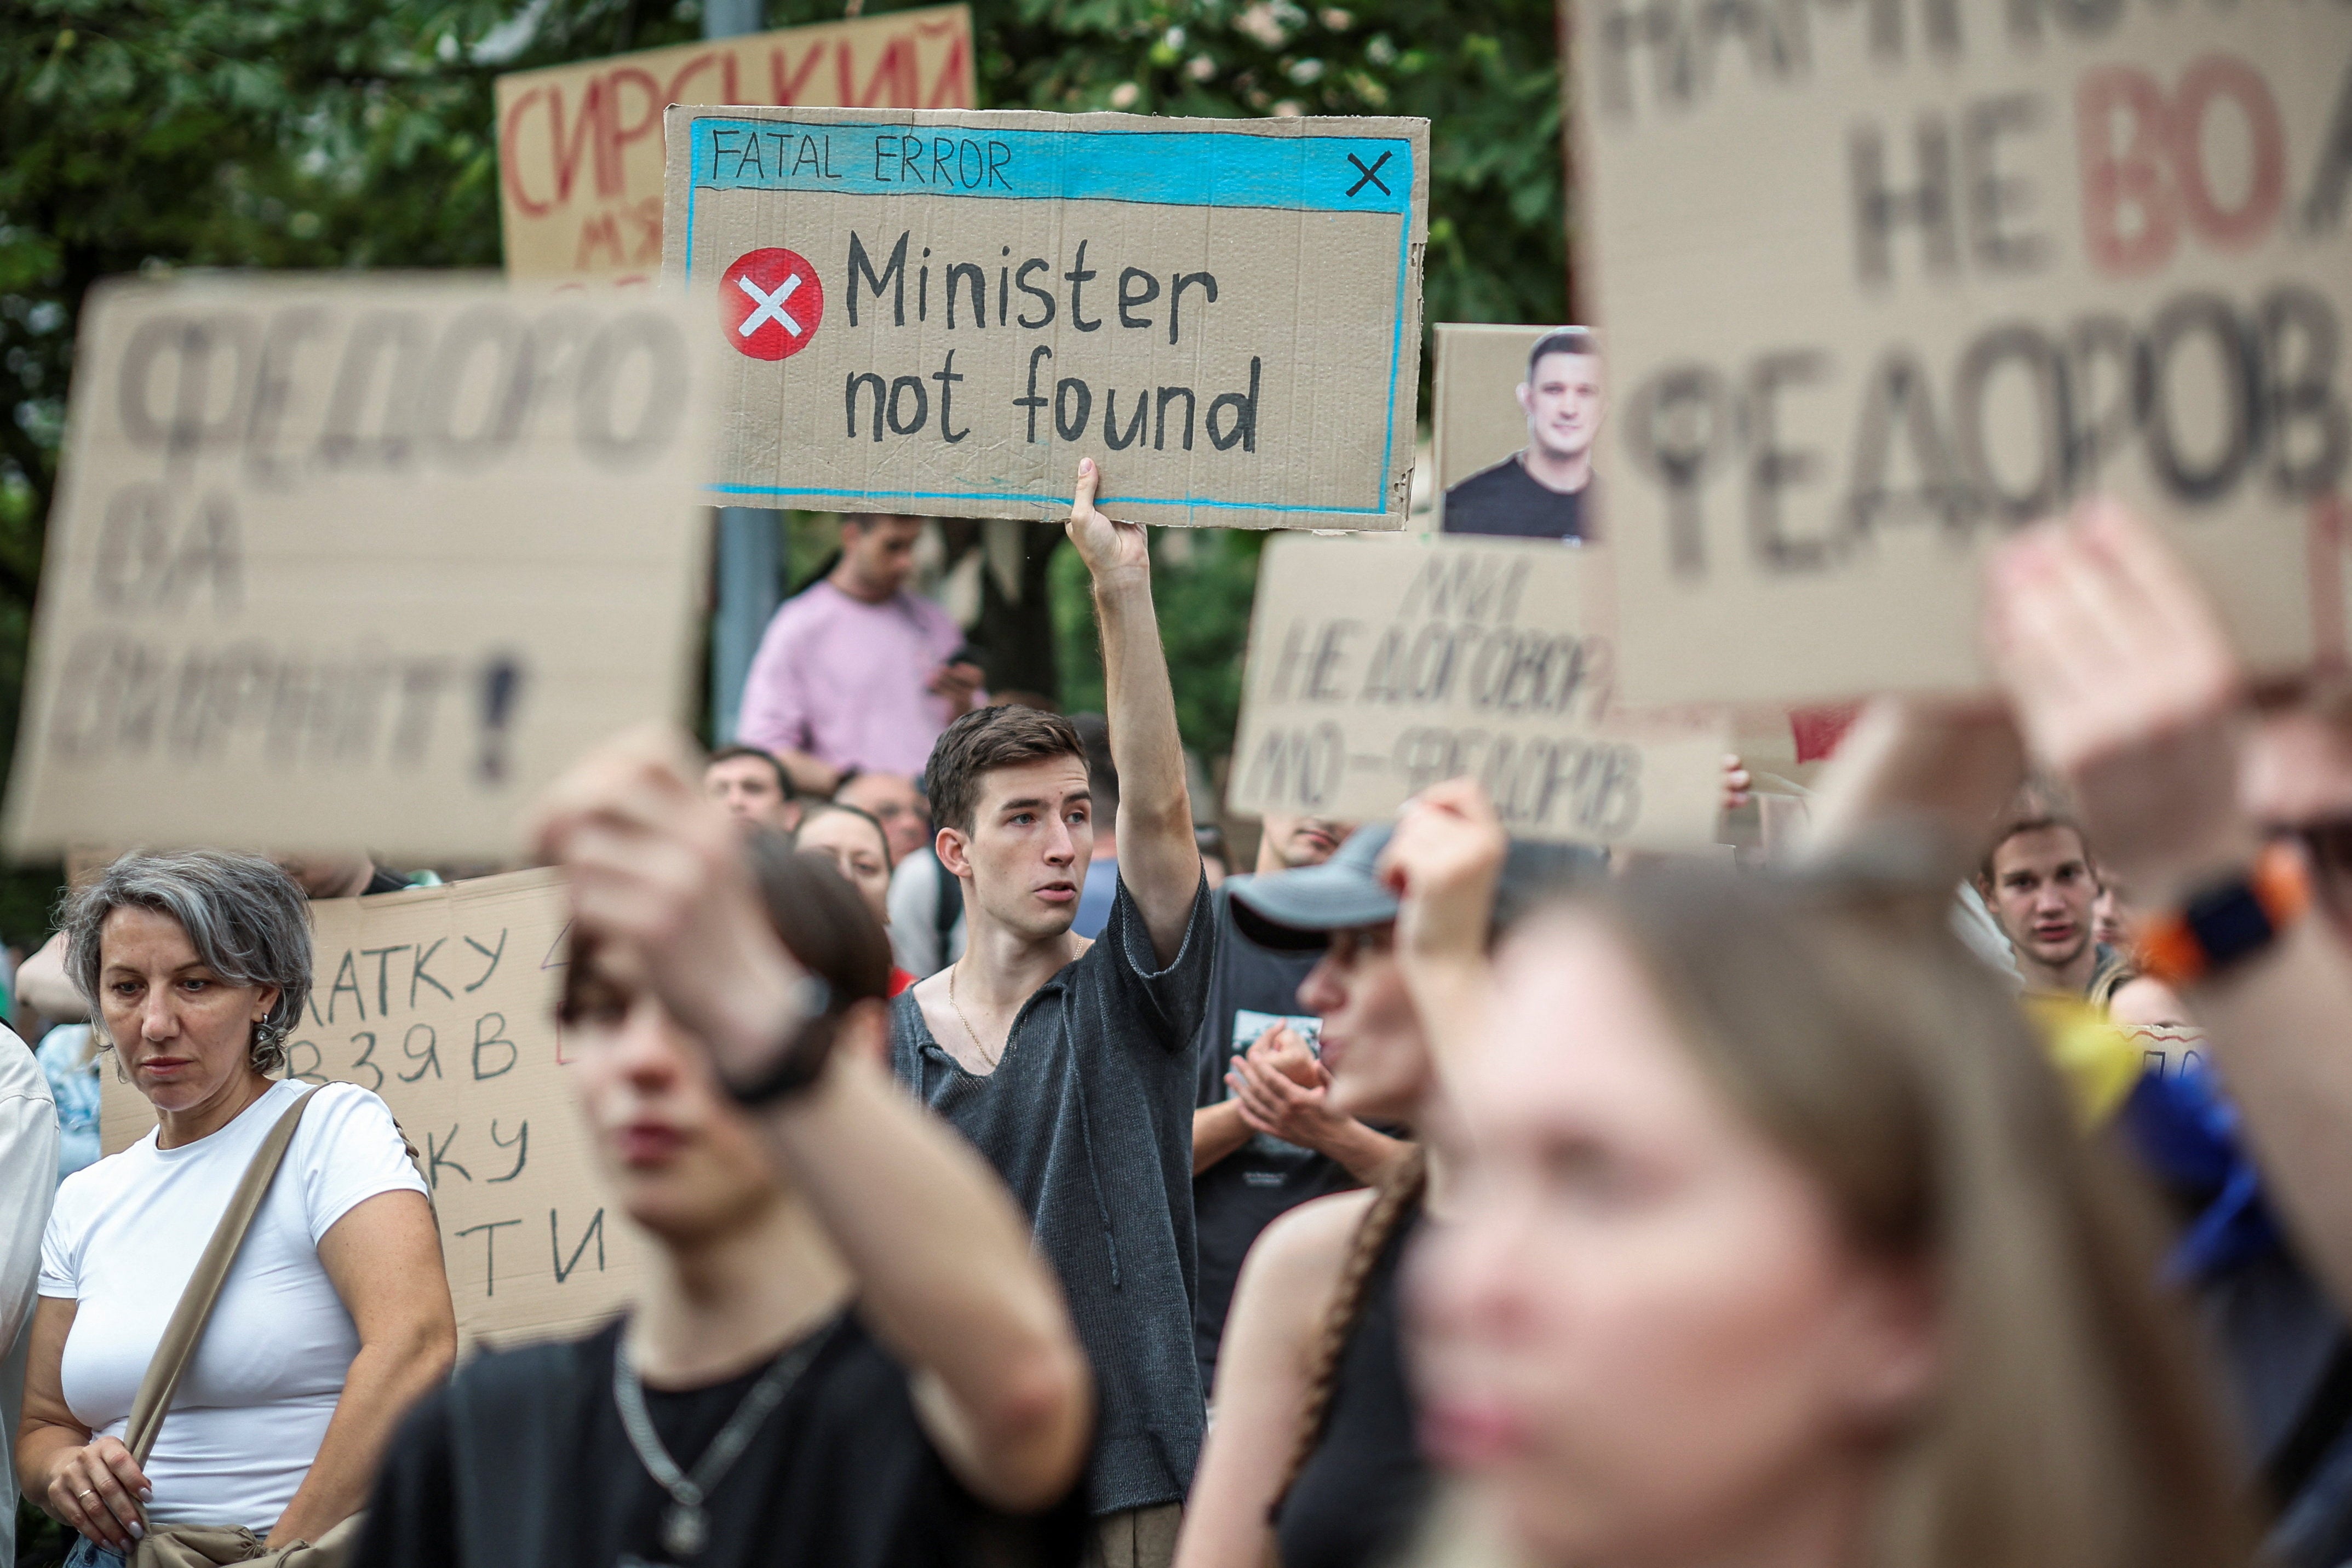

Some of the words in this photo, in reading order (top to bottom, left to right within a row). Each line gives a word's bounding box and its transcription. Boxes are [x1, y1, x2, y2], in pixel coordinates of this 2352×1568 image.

[712, 129, 843, 180] FATAL
[875, 135, 1013, 191] ERROR
[846, 229, 1219, 346] Minister
[845, 349, 970, 444] not
[1013, 344, 1260, 453] found
